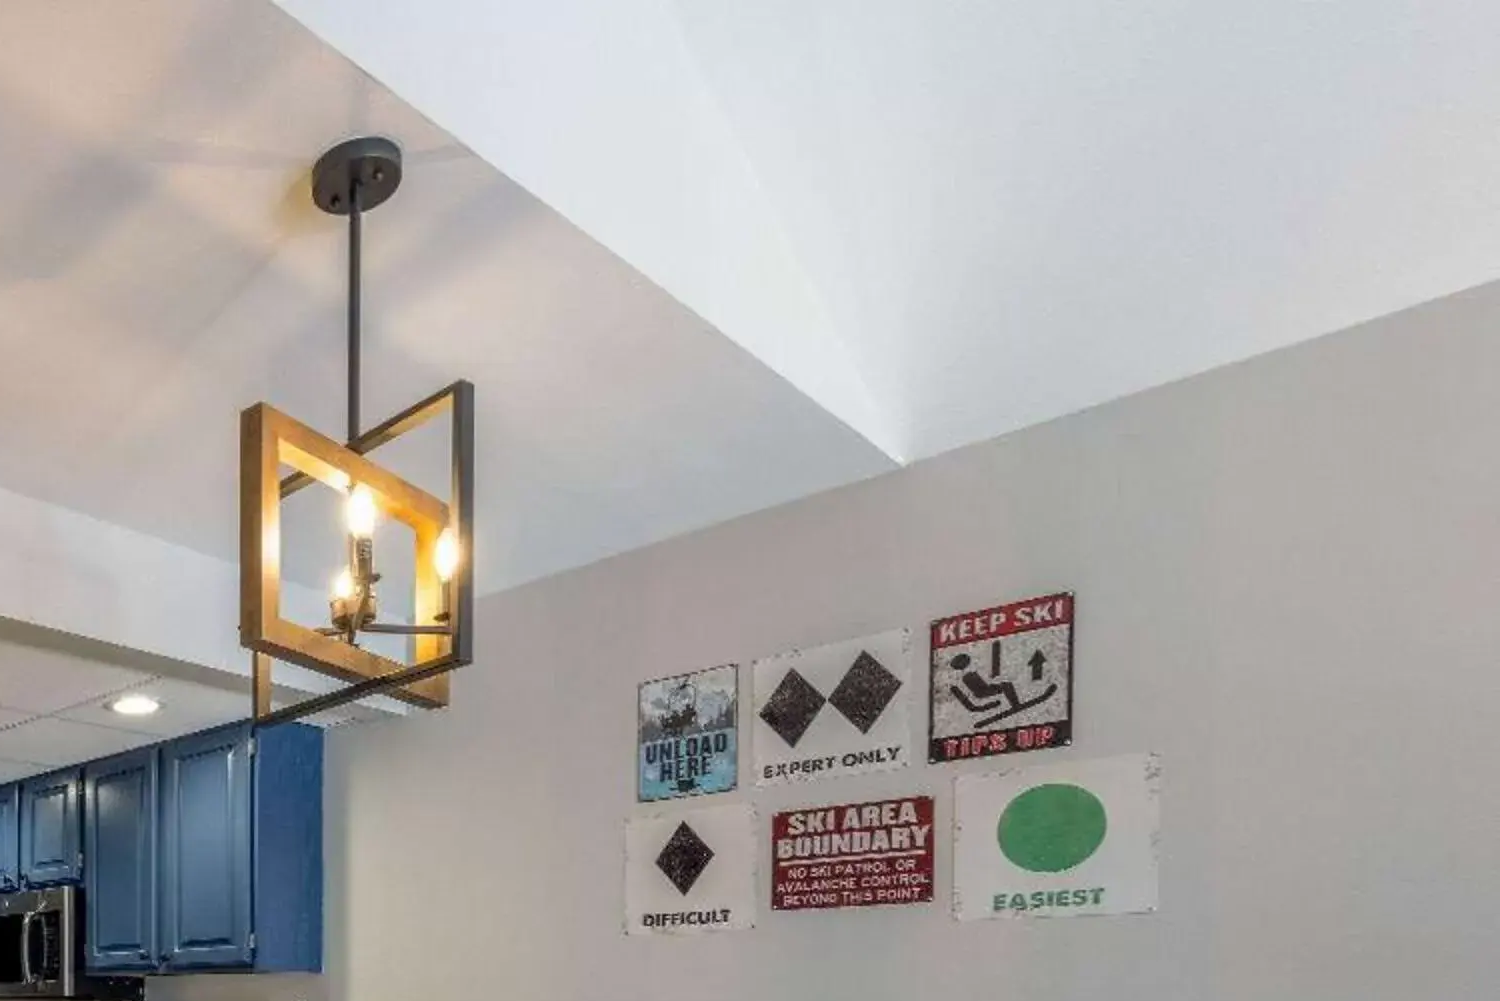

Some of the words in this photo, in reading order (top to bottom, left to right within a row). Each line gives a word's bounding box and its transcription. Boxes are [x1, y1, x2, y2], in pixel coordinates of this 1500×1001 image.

[940, 613, 1006, 642] KEEP
[1014, 600, 1063, 627] SKI
[645, 733, 727, 764] UNLOAD
[944, 733, 1007, 757] TIPS
[1017, 726, 1055, 748] UP
[660, 756, 712, 782] HERE
[763, 756, 836, 779] EXPERT
[842, 746, 901, 767] ONLY
[787, 809, 835, 835] SKI
[843, 801, 918, 829] AREA
[777, 824, 931, 858] BOUNDARY
[777, 877, 858, 893] AVALANCHE
[861, 873, 929, 888] CONTROL
[787, 867, 807, 880] NO
[809, 865, 832, 878] SKI
[835, 861, 891, 876] PATROL
[895, 859, 916, 871] OR
[783, 893, 838, 907] BEYOND
[842, 890, 873, 904] THIS
[876, 887, 921, 901] POINT
[993, 887, 1105, 911] EASIEST
[643, 909, 731, 927] DIFFICULT
